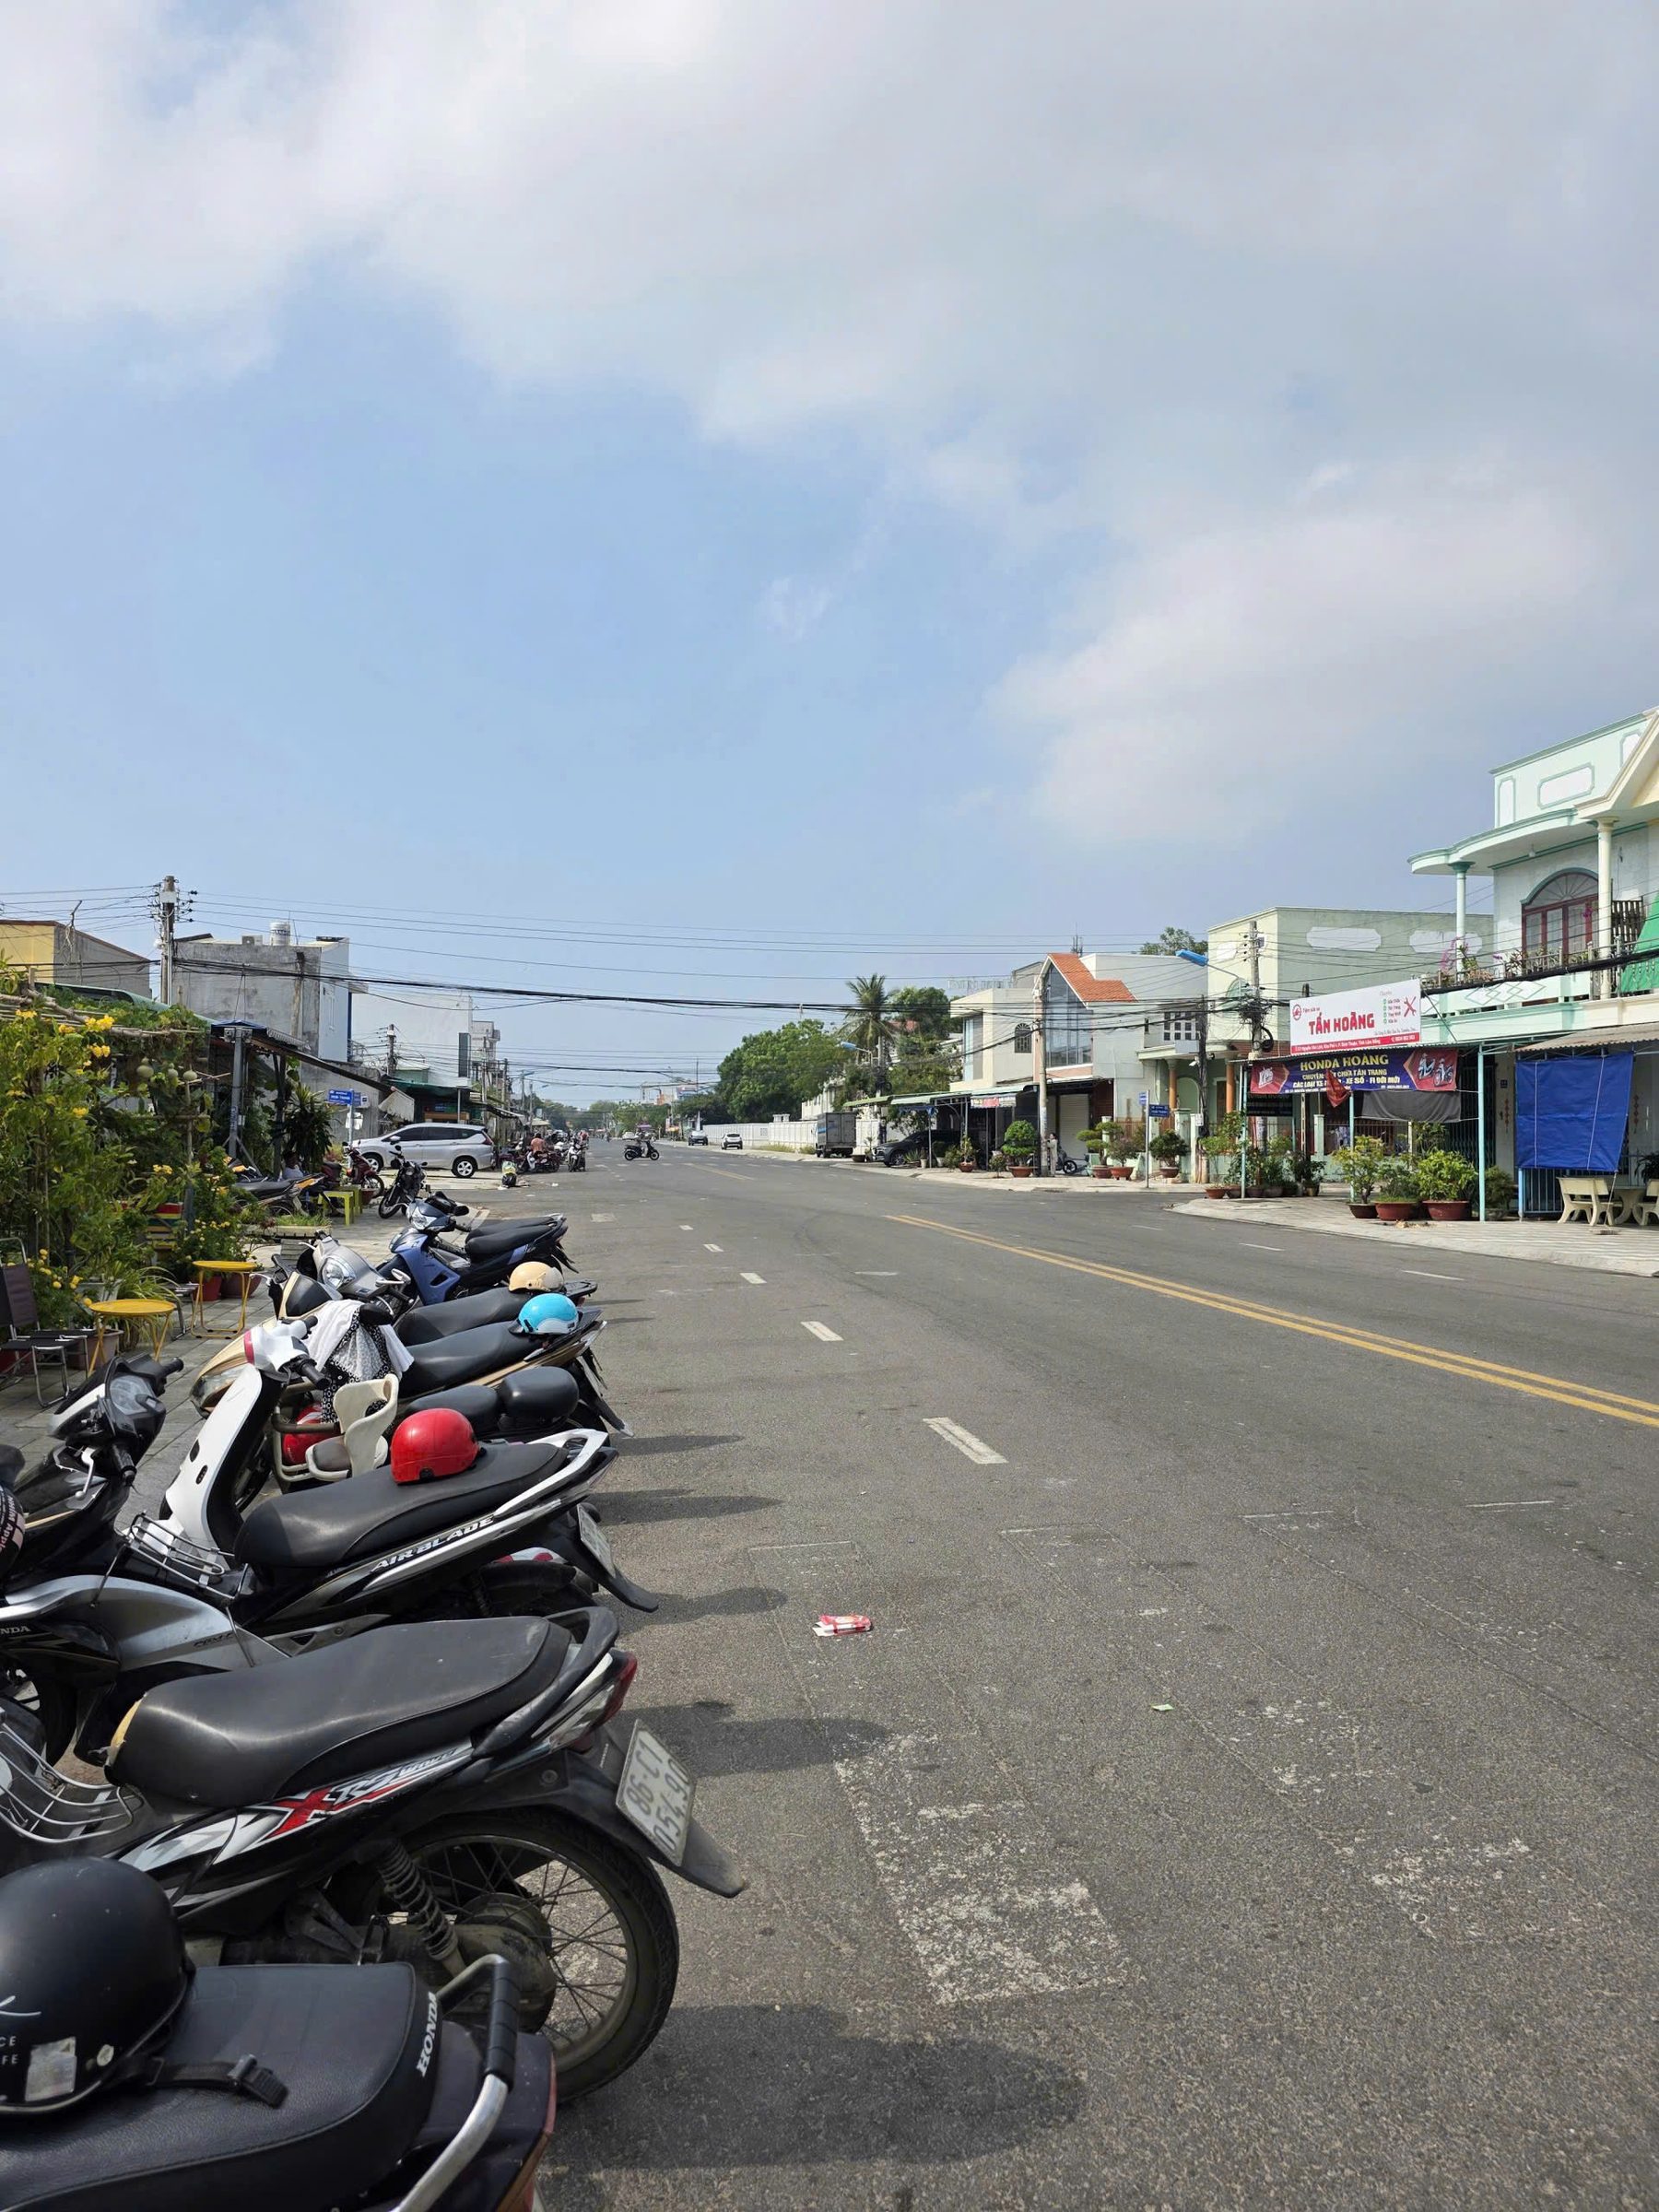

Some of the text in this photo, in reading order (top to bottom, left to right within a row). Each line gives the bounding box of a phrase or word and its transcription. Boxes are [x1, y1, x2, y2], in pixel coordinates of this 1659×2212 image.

[1300, 1059, 1340, 1071] HONDA
[0, 1625, 31, 1634] NDA
[416, 1991, 438, 2077] HONDA
